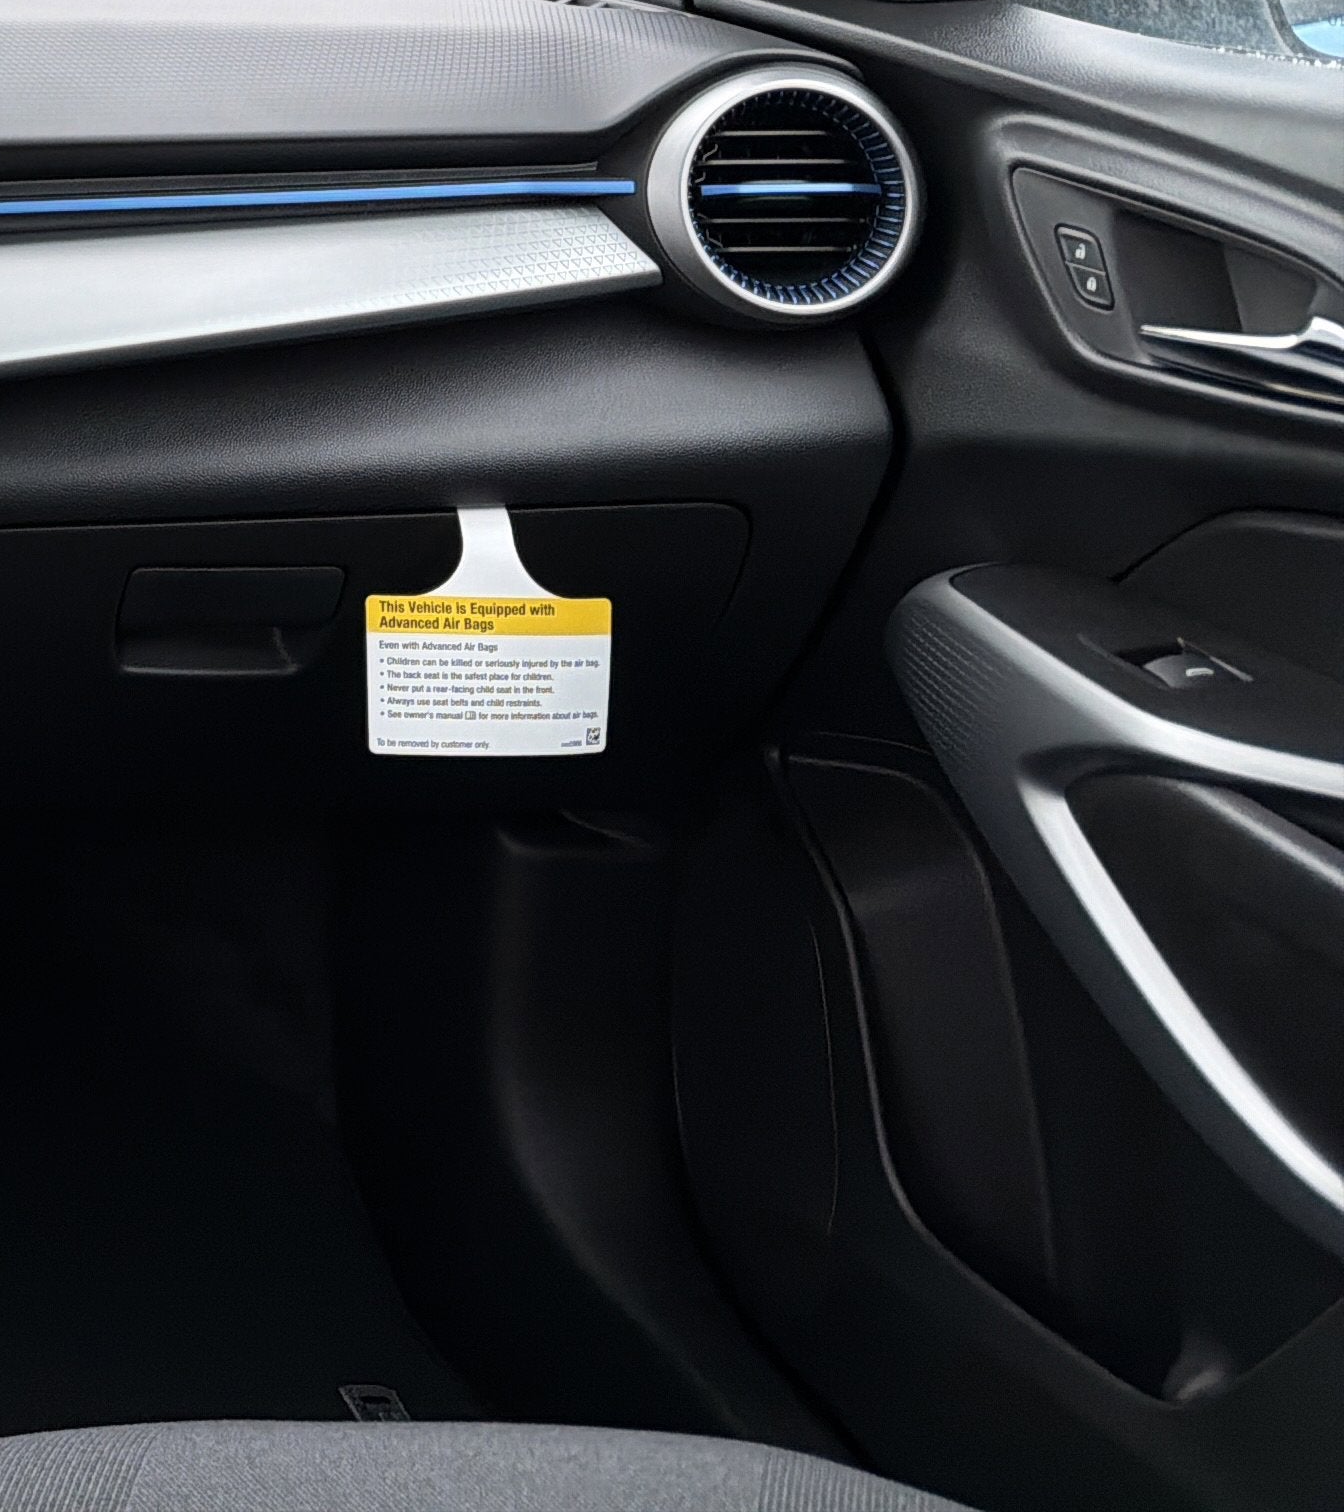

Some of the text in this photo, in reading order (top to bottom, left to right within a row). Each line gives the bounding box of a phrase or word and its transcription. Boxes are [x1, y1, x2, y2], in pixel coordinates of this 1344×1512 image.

[379, 600, 405, 613] This
[408, 601, 453, 615] Vehicle
[470, 602, 526, 618] Equipped
[529, 604, 556, 616] with
[379, 615, 495, 633] Advanced Air Bags
[379, 640, 499, 653] Even with Advanced Air Bags
[386, 656, 421, 666] Children
[422, 659, 437, 667] can
[439, 658, 449, 666] be
[451, 658, 473, 667] killed
[485, 659, 520, 669] seriously
[522, 659, 548, 670] injured
[550, 660, 559, 669] by
[561, 659, 572, 668] the
[574, 659, 584, 667] air
[387, 670, 402, 679] The
[403, 670, 422, 679] back
[424, 672, 440, 680] seat
[451, 672, 463, 680] the
[465, 672, 488, 680] safest
[489, 673, 509, 682] place
[511, 673, 522, 681] for
[387, 683, 410, 692] Never
[412, 685, 425, 694] put
[433, 685, 475, 695] rear-facing
[476, 686, 495, 694] child
[496, 686, 512, 694] seat
[522, 686, 534, 694] the
[387, 697, 415, 707] Always
[433, 699, 449, 707] seat
[451, 699, 469, 707] belts
[471, 699, 485, 707] and
[486, 699, 504, 707] child
[387, 710, 402, 719] See
[436, 711, 463, 720] manual
[479, 712, 489, 720] for
[511, 712, 551, 720] information
[552, 712, 572, 720] about
[573, 711, 581, 719] air
[377, 737, 386, 747] To
[387, 739, 397, 747] be
[398, 739, 429, 748] removed
[431, 740, 440, 750] by
[441, 740, 473, 748] customer
